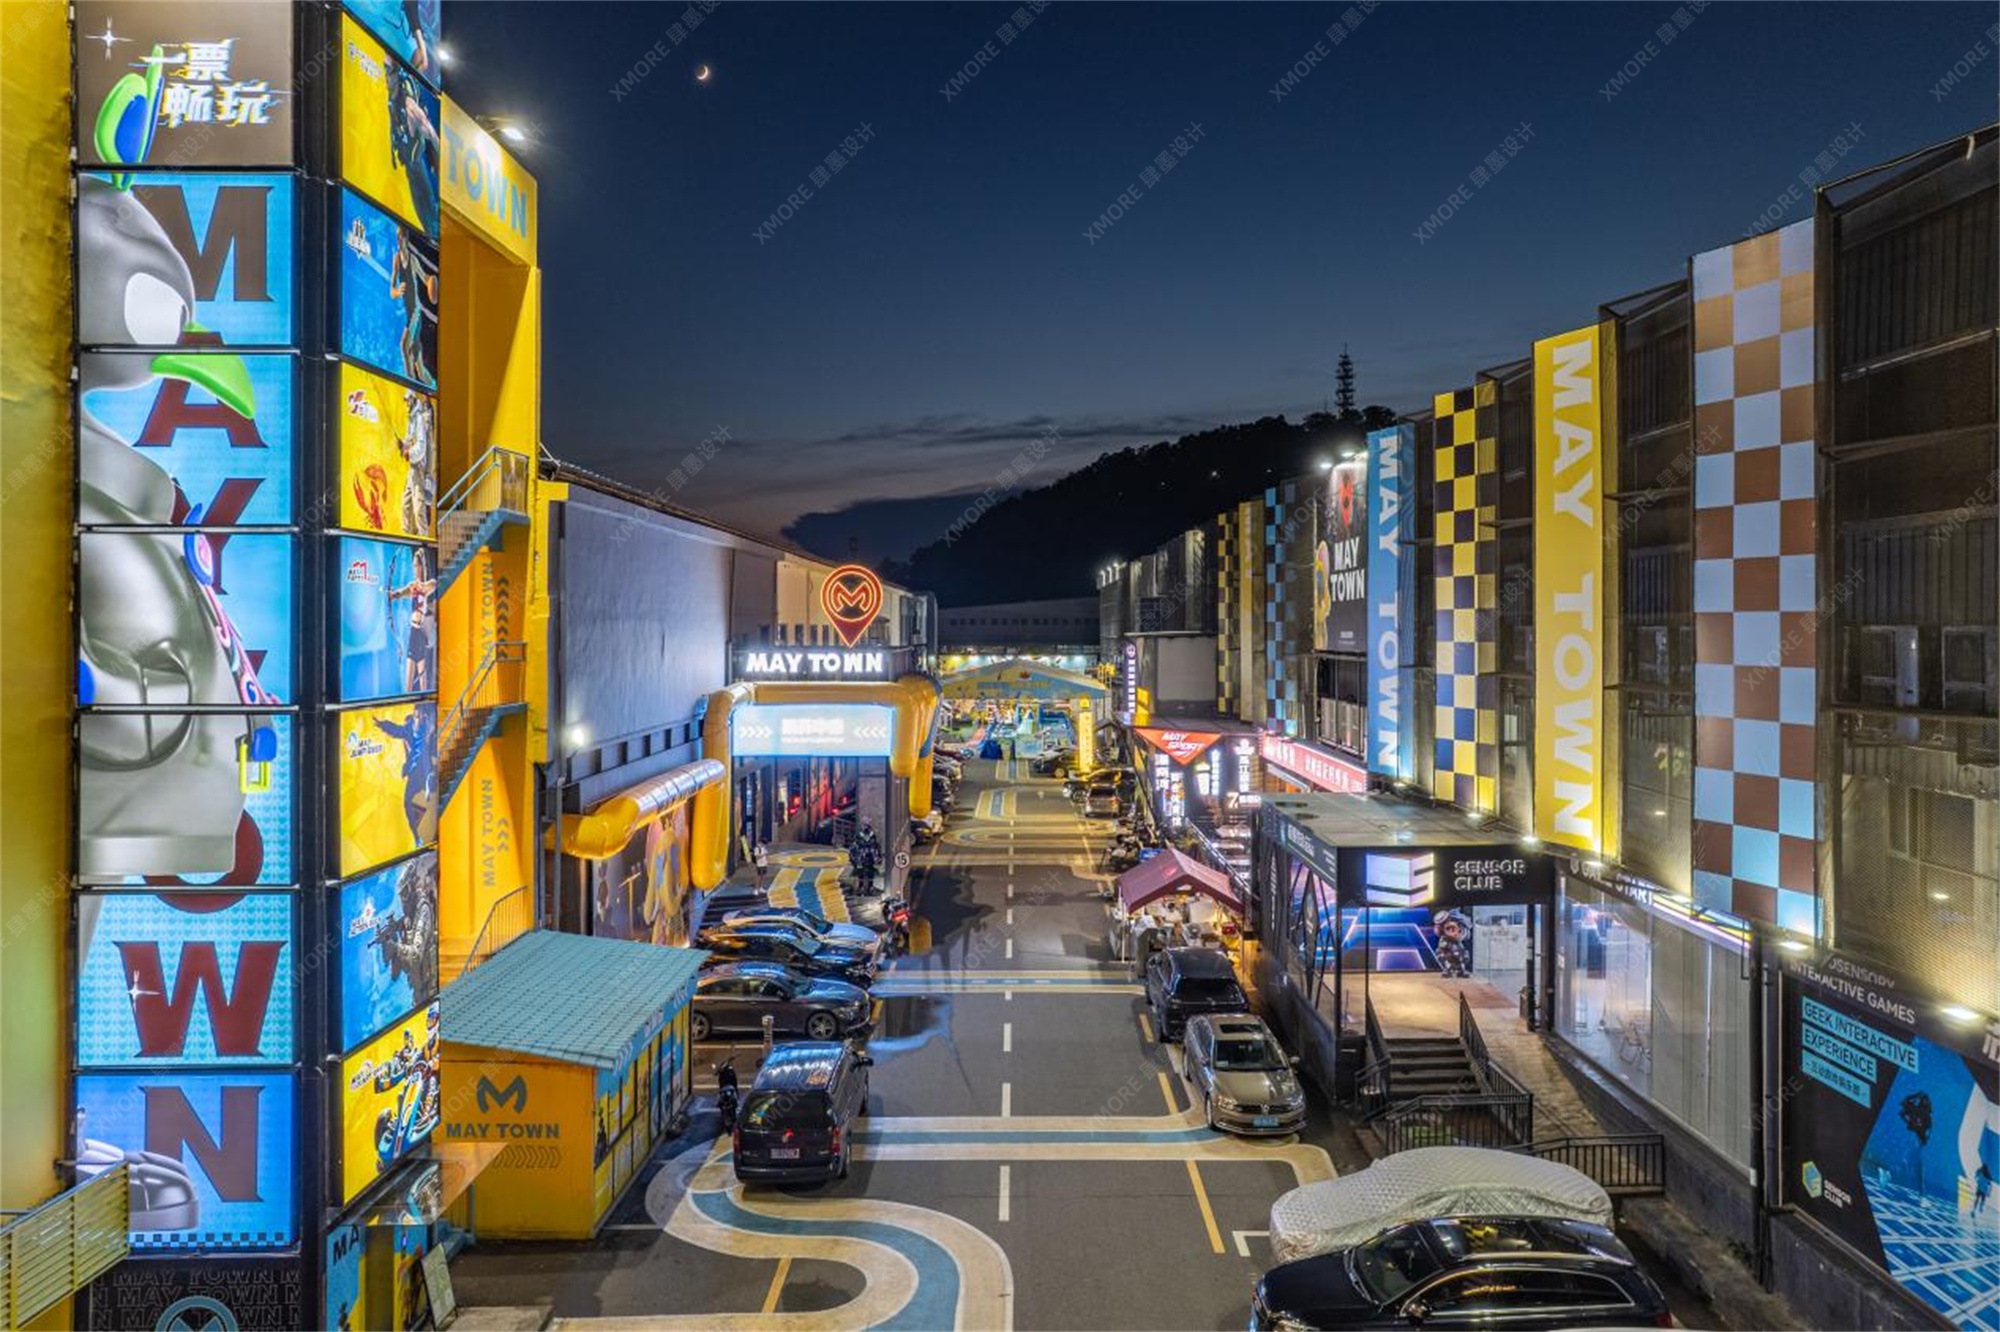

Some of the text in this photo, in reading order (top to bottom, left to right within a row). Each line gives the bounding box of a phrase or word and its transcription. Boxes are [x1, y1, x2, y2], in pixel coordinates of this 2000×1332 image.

[160, 80, 284, 128] 畅玩
[442, 128, 529, 240] TOWN
[1334, 537, 1360, 571] MAY
[482, 563, 493, 618] TOWN
[1330, 569, 1365, 602] TOWN
[1378, 432, 1402, 769] MAY TOWN
[1553, 335, 1593, 835] MAY TOWN
[746, 652, 884, 674] MAY TOWN
[1161, 731, 1188, 741] MAY
[481, 779, 495, 887] MAY TOWN
[896, 853, 908, 866] 15
[1453, 858, 1528, 876] SENSOR
[1453, 875, 1502, 891] CLUB
[1790, 959, 1916, 1025] INTERACTIVE GAMES
[1804, 1002, 1916, 1068] GEEK INTERACTIVE
[1804, 1029, 1875, 1077] EXPERIENCE
[446, 1123, 560, 1138] MAY TOWN
